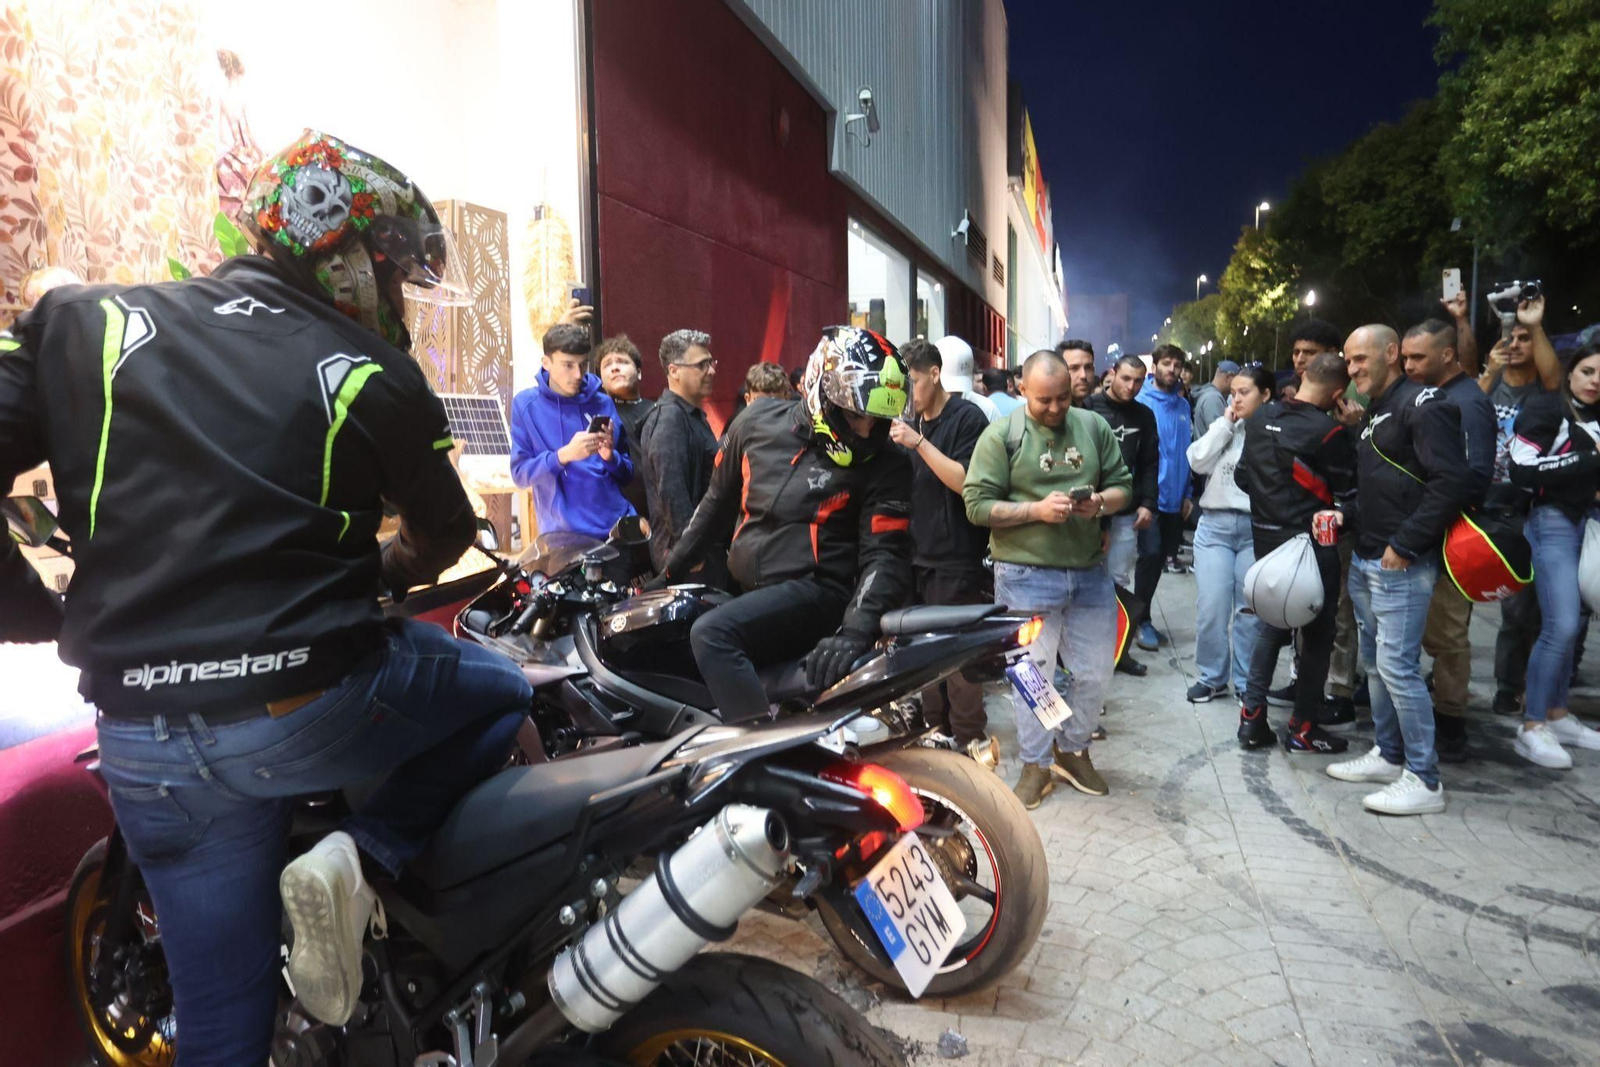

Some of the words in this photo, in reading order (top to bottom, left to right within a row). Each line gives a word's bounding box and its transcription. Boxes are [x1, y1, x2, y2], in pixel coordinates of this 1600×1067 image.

[122, 647, 311, 691] alpinestars
[875, 845, 934, 919] 5243
[905, 896, 952, 966] GYM
